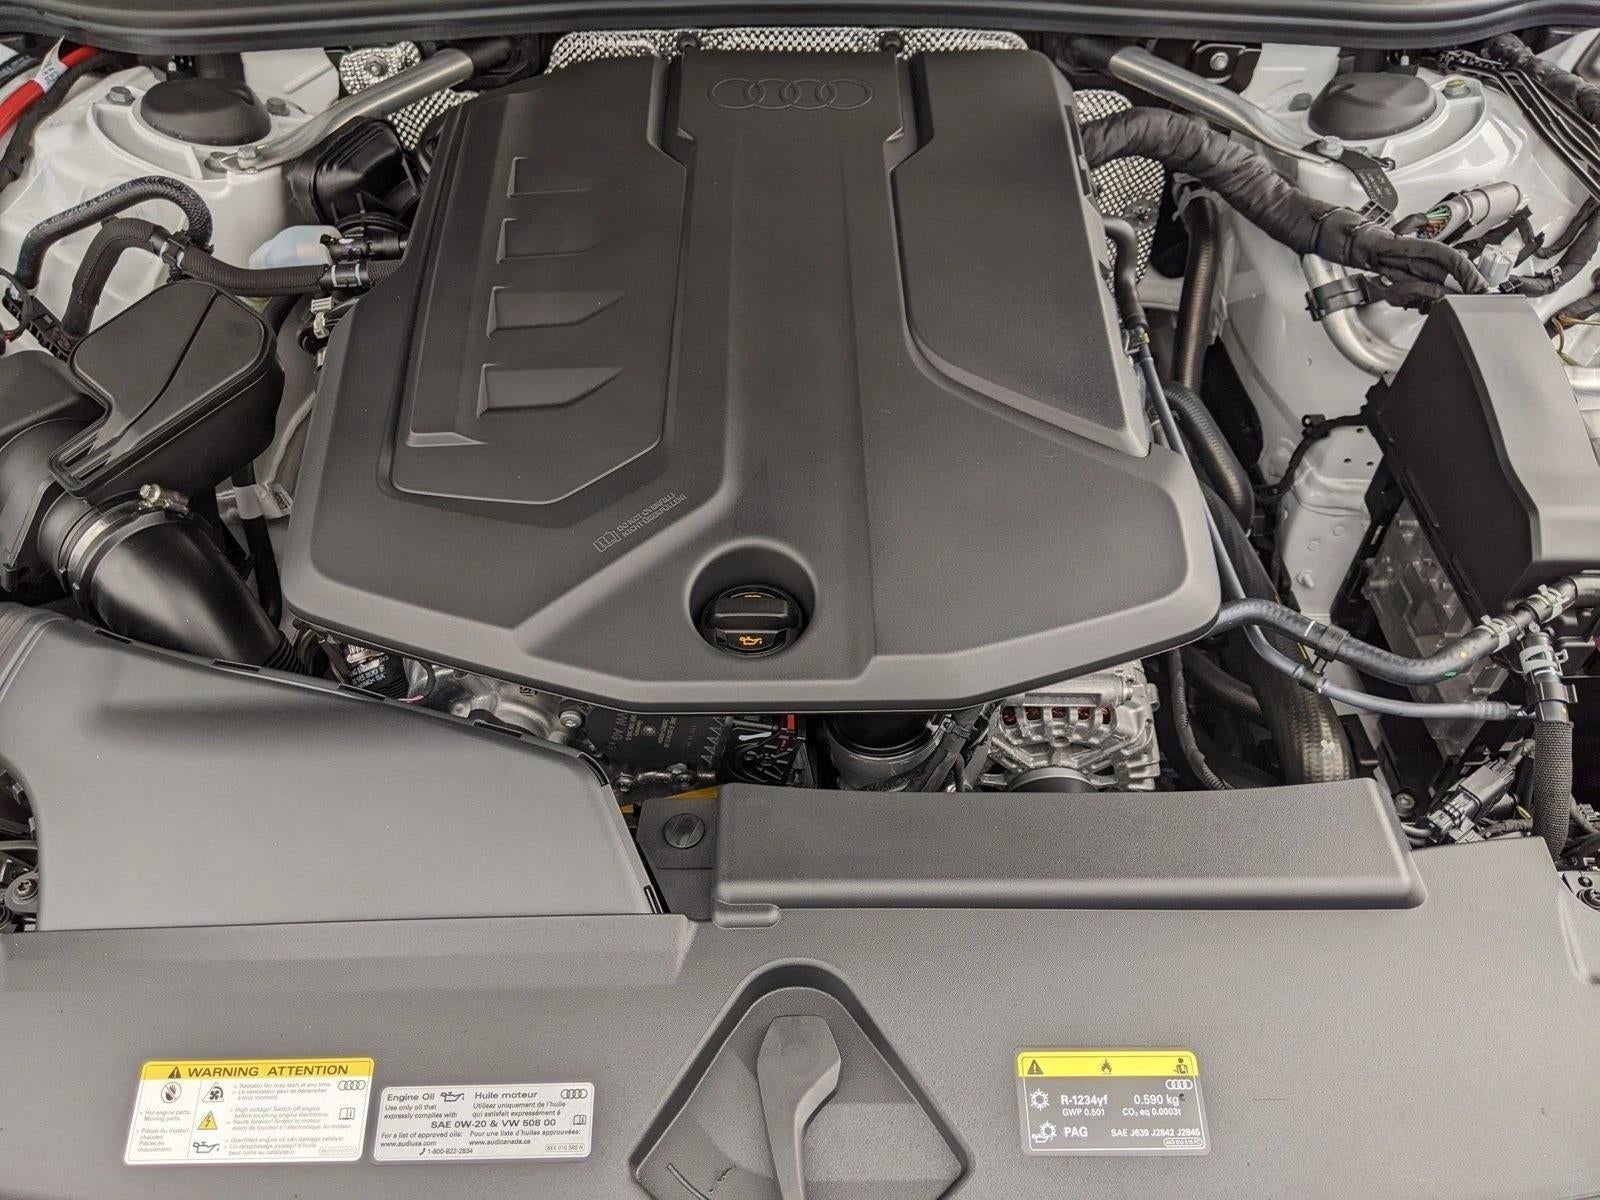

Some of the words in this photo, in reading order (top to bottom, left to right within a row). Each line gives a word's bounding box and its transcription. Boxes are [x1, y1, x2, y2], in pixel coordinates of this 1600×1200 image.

[187, 1066, 259, 1078] WARNING
[267, 1064, 349, 1077] ATTENTION
[387, 1093, 419, 1103] Engine
[422, 1092, 435, 1101] Oil
[474, 1091, 499, 1099] Huile
[501, 1091, 538, 1099] moteur
[1060, 1094, 1108, 1107] R-1234yf
[1133, 1094, 1164, 1105] 0.590
[1166, 1094, 1179, 1106] kg
[398, 1104, 412, 1112] only
[473, 1101, 496, 1109] Utilisez
[497, 1101, 535, 1110] uniquement
[384, 1112, 413, 1120] expressly
[415, 1111, 442, 1119] complies
[472, 1110, 483, 1118] qui
[510, 1109, 556, 1118] expressément
[1062, 1108, 1082, 1117] GWP
[1084, 1108, 1105, 1117] 0.501
[1139, 1109, 1150, 1118] eq
[1151, 1107, 1182, 1116] 0.0003t
[430, 1121, 452, 1129] SAE
[454, 1120, 487, 1129] 0W-20
[489, 1119, 498, 1128] &
[502, 1119, 520, 1128] VW
[522, 1118, 541, 1127] 508
[543, 1118, 557, 1127] 00
[417, 1131, 448, 1140] approved
[469, 1130, 485, 1138] Pour
[500, 1129, 513, 1137] liste
[1064, 1126, 1088, 1138] PAG
[1111, 1129, 1128, 1138] SAE
[1130, 1128, 1150, 1138] J639
[1151, 1128, 1174, 1138] J2842
[380, 1140, 437, 1148] www.audiusa.com
[469, 1139, 531, 1147] www.audicanada.ca
[427, 1147, 473, 1155] 1-800-822-2834
